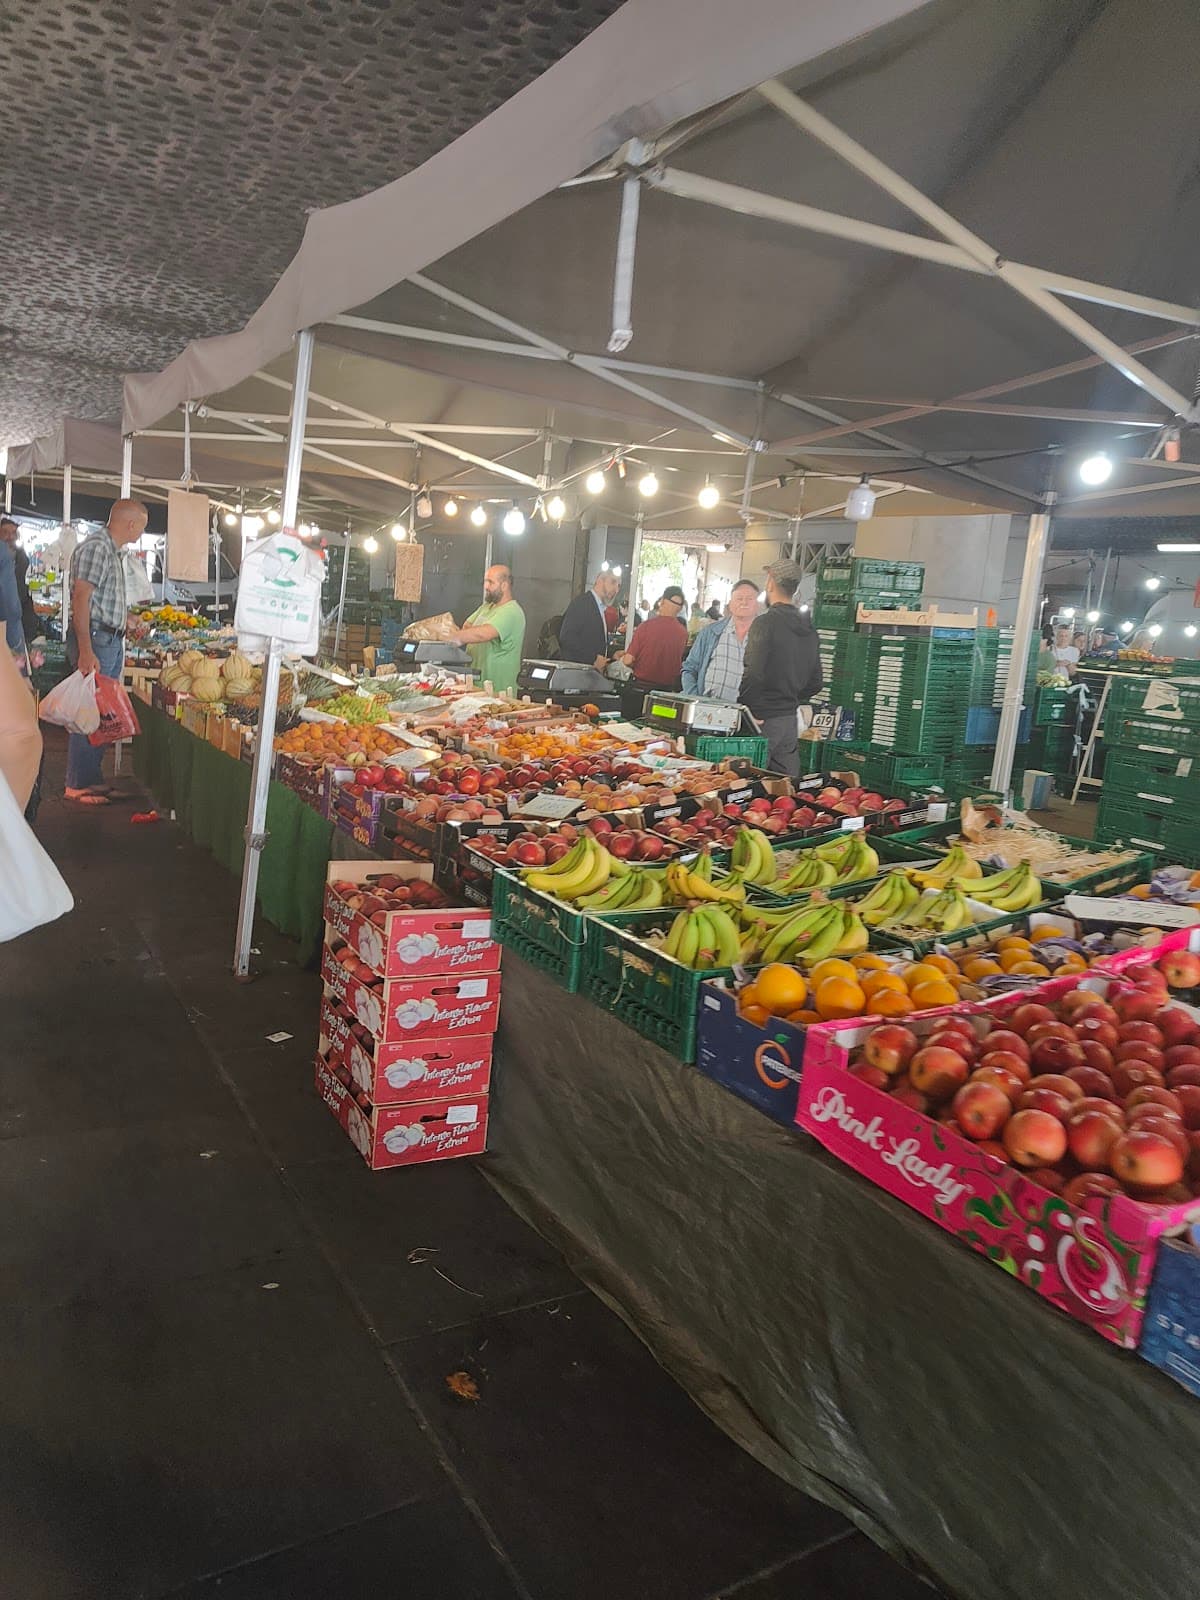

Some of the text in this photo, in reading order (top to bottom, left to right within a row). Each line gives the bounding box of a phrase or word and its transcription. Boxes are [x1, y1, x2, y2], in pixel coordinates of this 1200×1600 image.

[433, 944, 466, 959] Intense
[431, 1008, 465, 1023] Intense
[422, 1067, 455, 1082] Intense
[420, 1131, 452, 1147] Intense
[809, 1086, 967, 1205] Pink Lady
